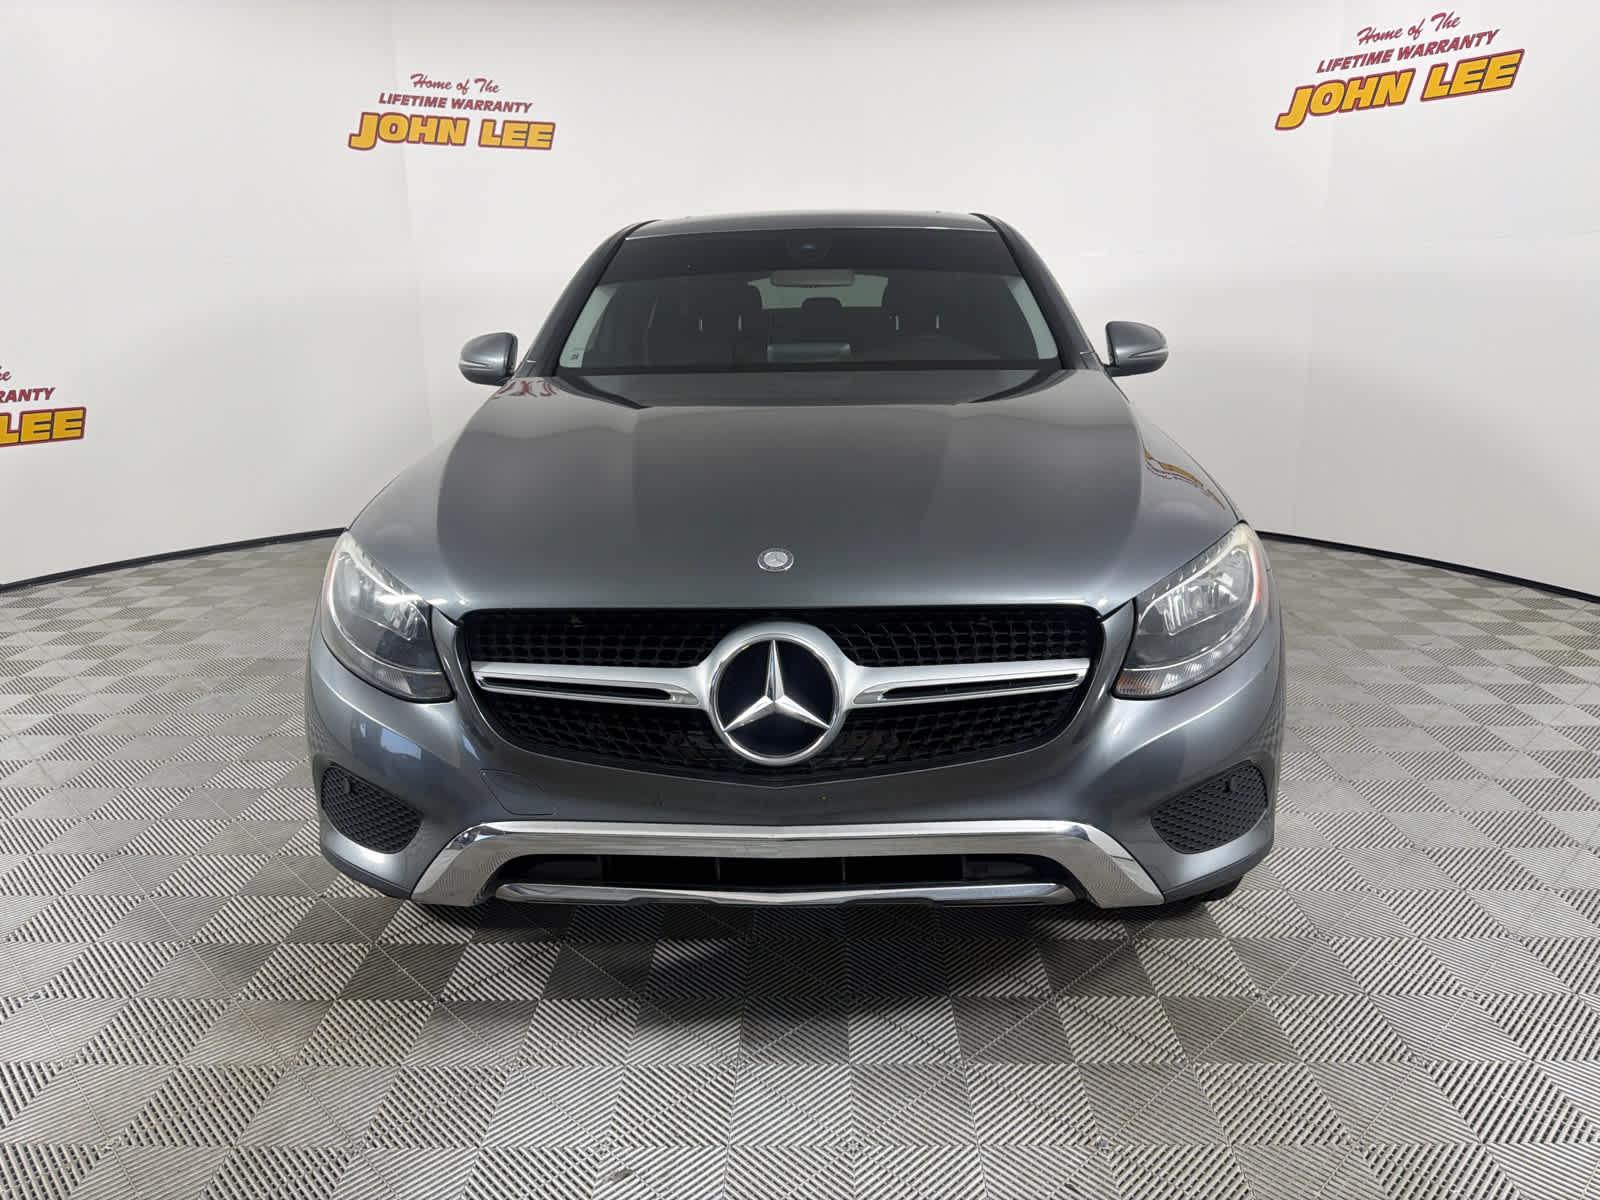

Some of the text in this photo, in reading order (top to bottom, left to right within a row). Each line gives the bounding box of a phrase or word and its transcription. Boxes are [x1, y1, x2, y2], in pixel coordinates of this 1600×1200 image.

[1357, 11, 1460, 46] Home of The
[1316, 29, 1500, 74] LIFETIME WARRANTY
[378, 92, 532, 113] LIFETIME WARRANTY
[410, 73, 500, 95] Home of The
[1275, 49, 1525, 131] JOHN LEE
[348, 112, 556, 151] JOHN LEE
[0, 406, 86, 448] LEE
